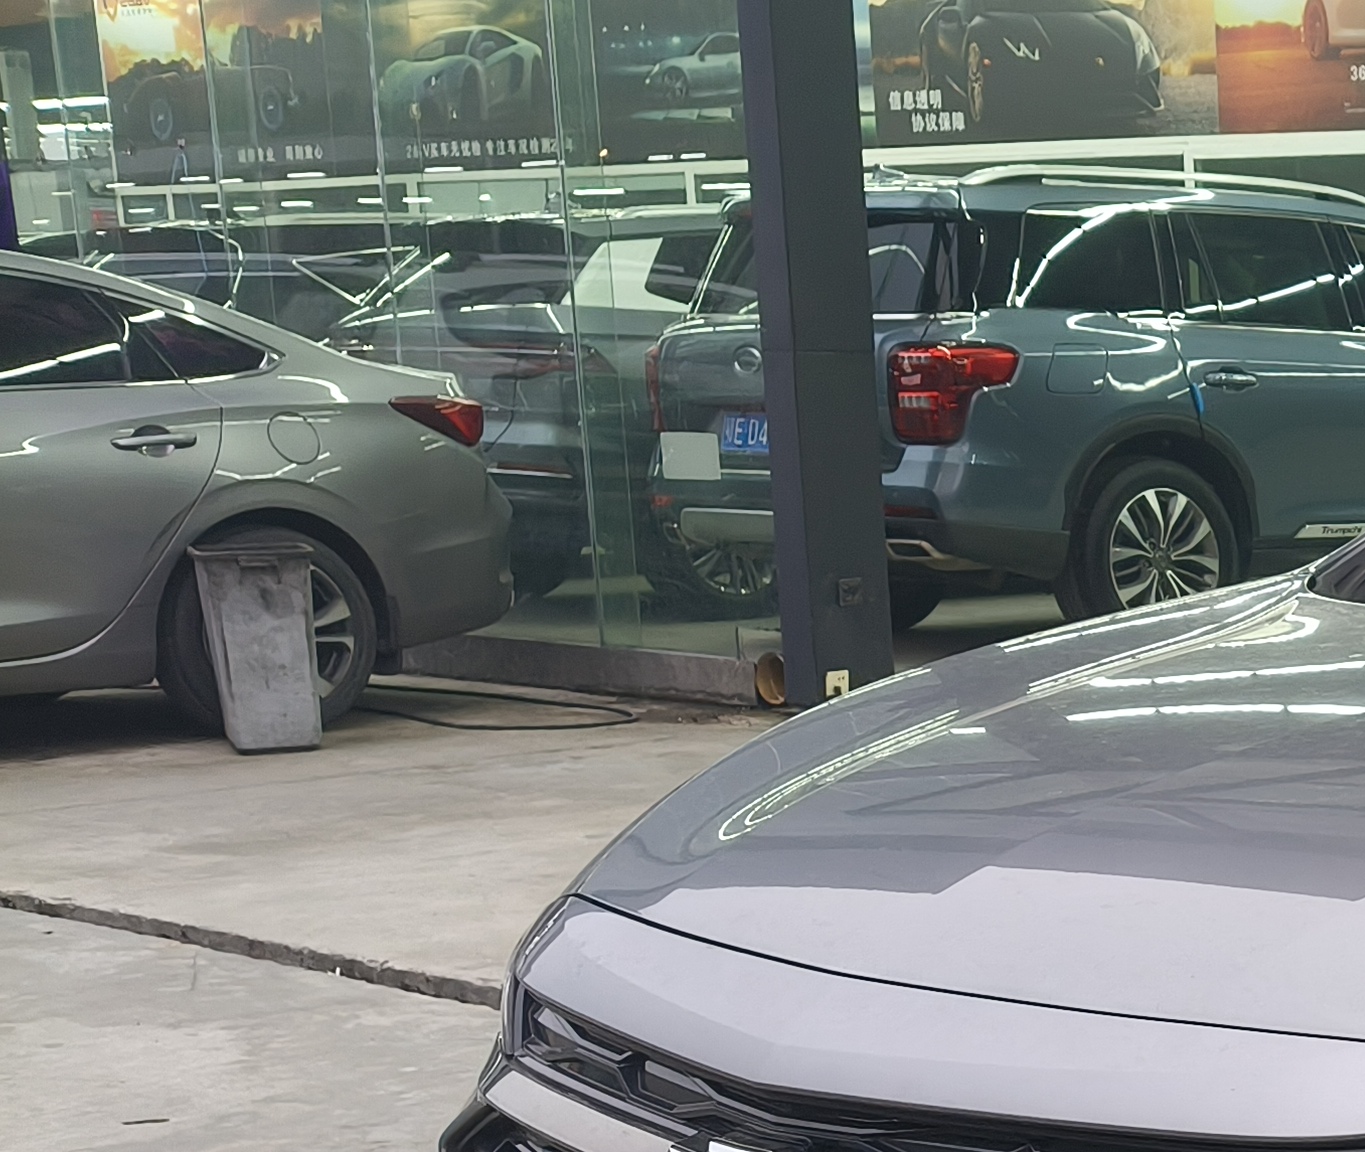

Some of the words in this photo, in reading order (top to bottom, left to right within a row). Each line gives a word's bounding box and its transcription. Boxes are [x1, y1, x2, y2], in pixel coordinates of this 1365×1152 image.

[889, 89, 942, 111] 信息透明
[911, 111, 966, 132] 协议保障
